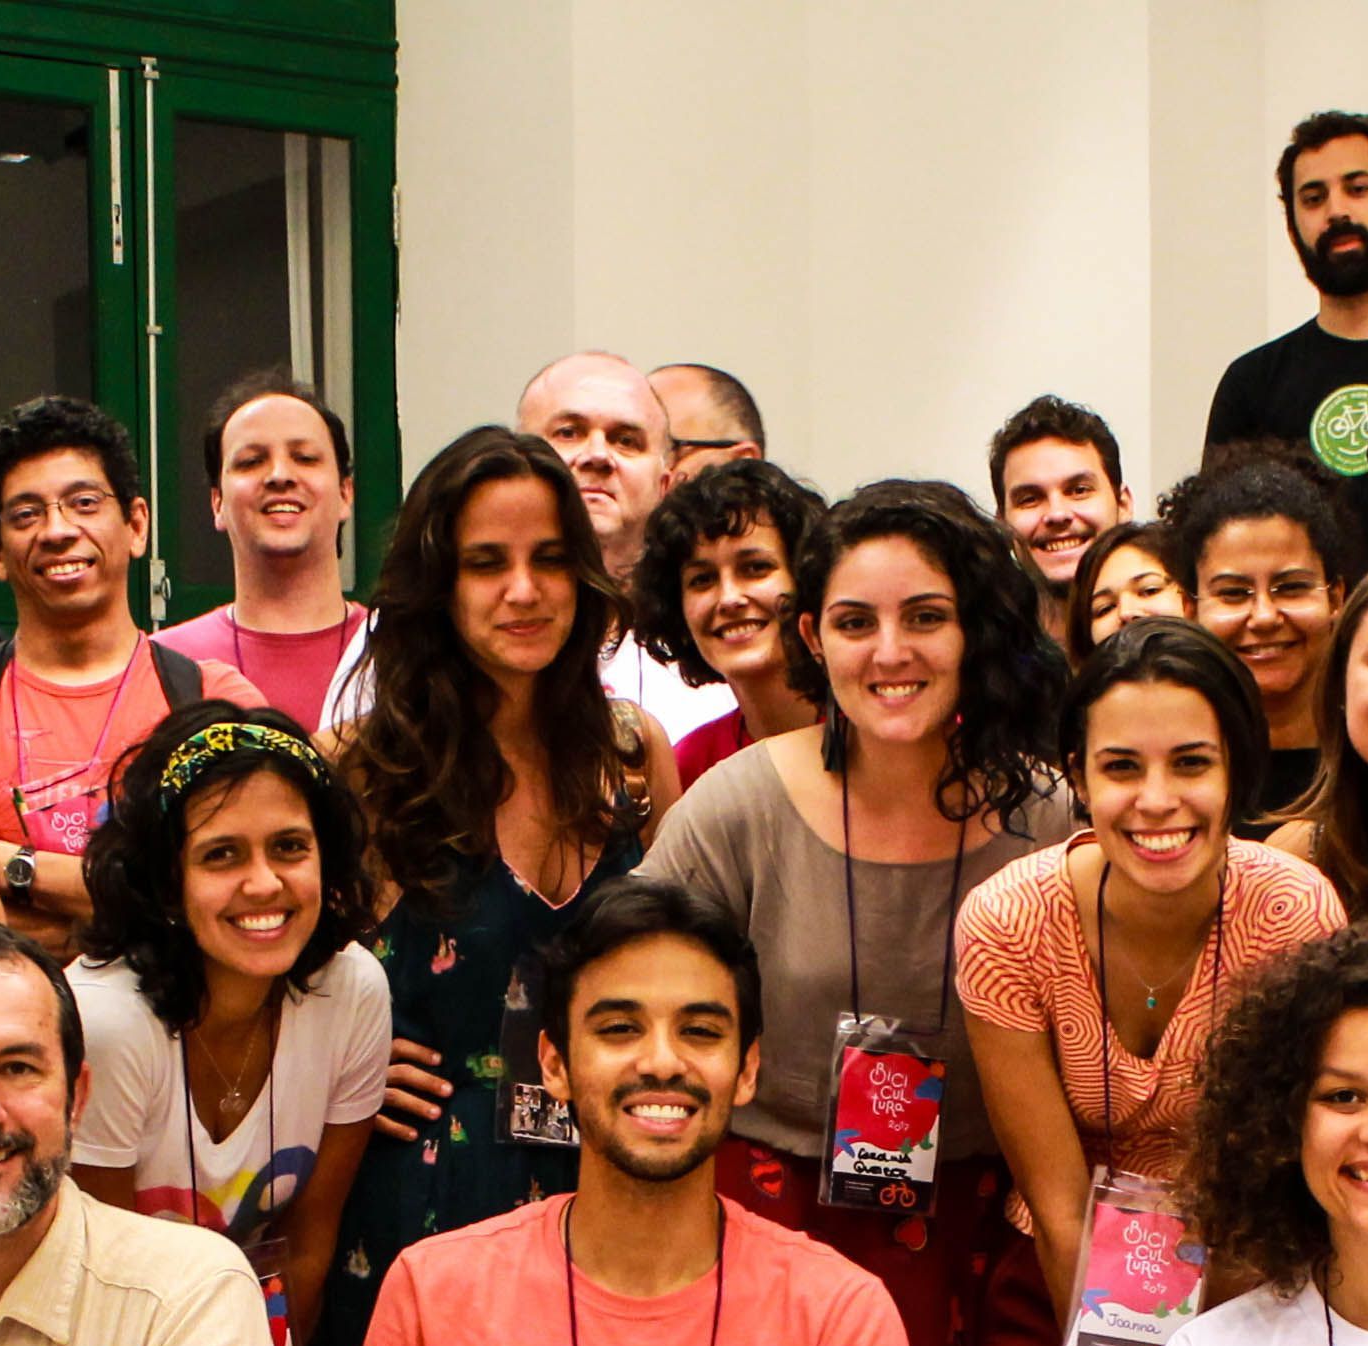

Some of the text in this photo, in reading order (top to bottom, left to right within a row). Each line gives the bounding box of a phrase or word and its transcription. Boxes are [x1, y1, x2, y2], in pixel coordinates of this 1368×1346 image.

[869, 1062, 908, 1087] BICI
[880, 1085, 912, 1104] CUL
[1123, 1220, 1167, 1248] BICI
[1135, 1245, 1170, 1265] CUL
[1107, 1313, 1162, 1335] Joanna
